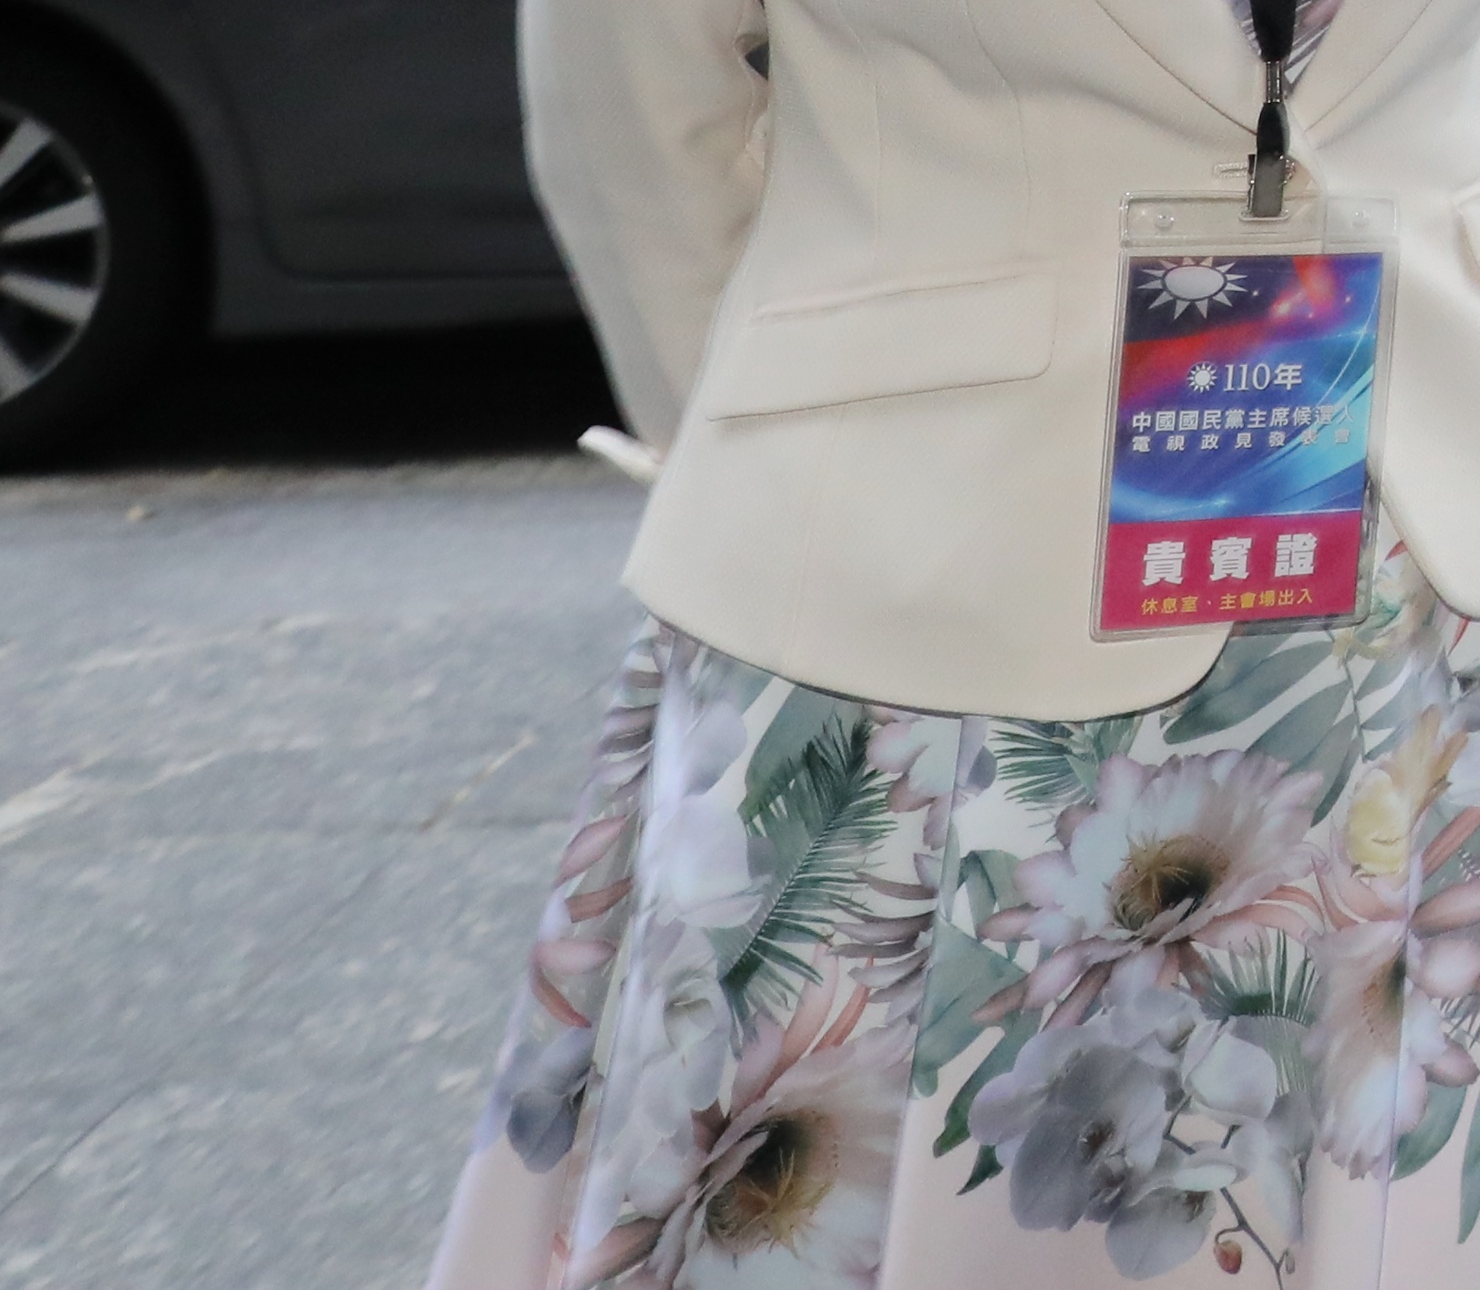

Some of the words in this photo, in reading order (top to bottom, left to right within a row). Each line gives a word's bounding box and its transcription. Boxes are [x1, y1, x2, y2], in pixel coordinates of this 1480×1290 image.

[1223, 362, 1303, 392] 110年
[1132, 404, 1354, 432] 中國國民黨主席候選人
[1131, 430, 1351, 453] 電視政見發表會
[1142, 532, 1319, 587] 貴賓證
[1140, 588, 1314, 615] 休息室、主會場出入
